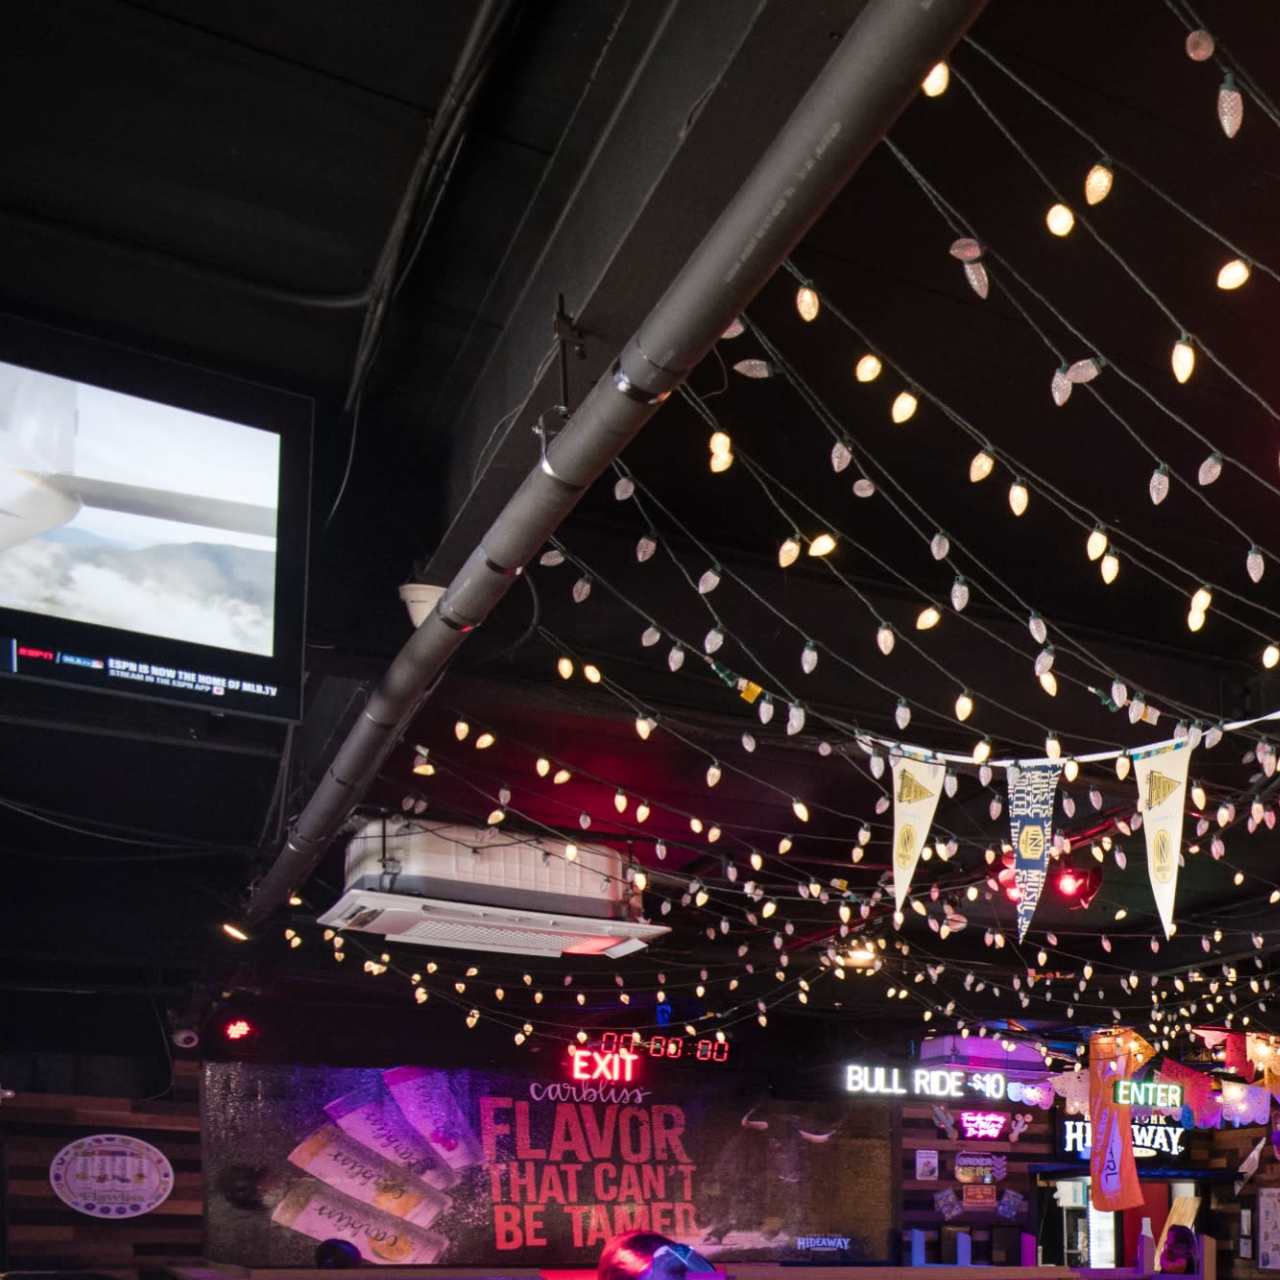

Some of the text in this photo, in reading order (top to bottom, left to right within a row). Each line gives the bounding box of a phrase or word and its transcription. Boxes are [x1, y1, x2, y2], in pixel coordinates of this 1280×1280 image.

[108, 657, 137, 672] ESPN
[150, 664, 177, 680] NOW
[178, 670, 196, 683] THE
[197, 674, 227, 688] HOME
[572, 1051, 639, 1081] EXIT
[529, 1078, 653, 1105] carbliss
[846, 1064, 1006, 1100] BULL RIDE $10
[1117, 1080, 1182, 1107] ENTER
[480, 1096, 693, 1163] FLAVOR
[488, 1161, 698, 1202] THAT CAN'T
[494, 1202, 700, 1250] BE TAMED
[797, 1236, 852, 1250] HIDEAWAY
